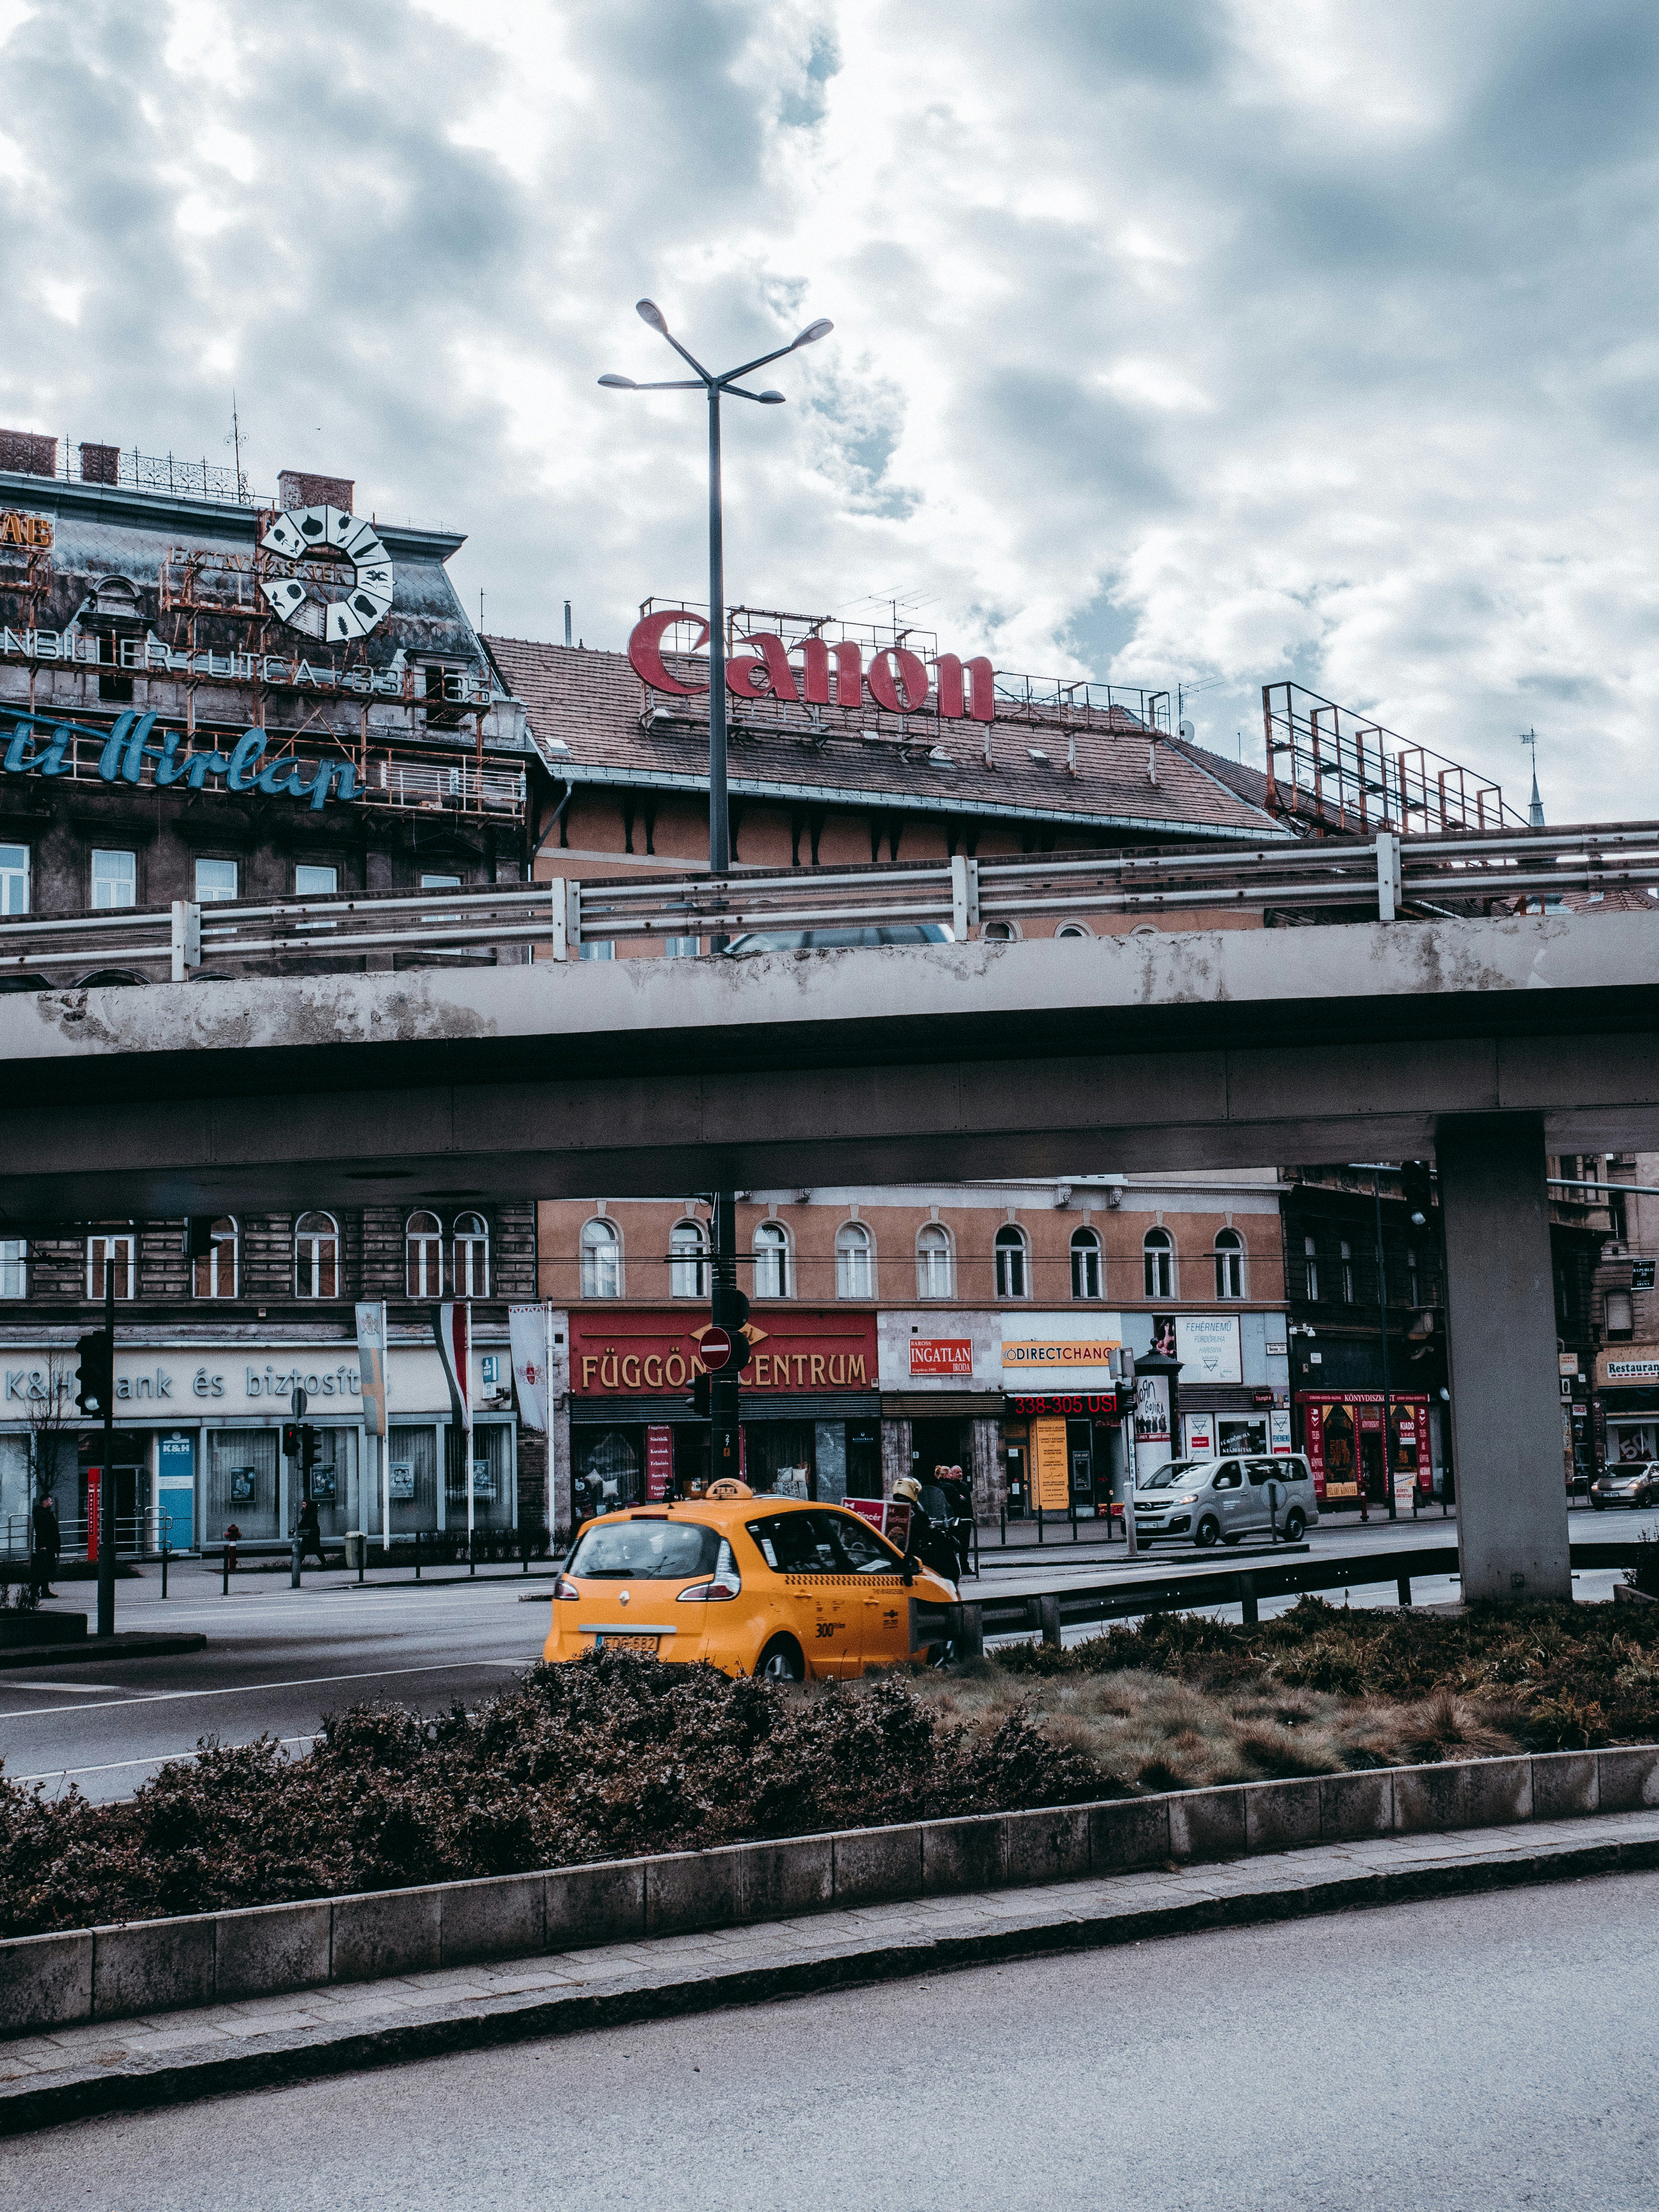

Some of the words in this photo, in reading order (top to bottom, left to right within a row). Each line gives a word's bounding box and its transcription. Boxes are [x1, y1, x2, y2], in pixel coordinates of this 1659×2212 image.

[208, 649, 321, 688] UTCA
[628, 610, 995, 721] Canon
[1186, 1321, 1231, 1331] FEHÉRNEMŰ
[911, 1348, 971, 1362] INGATLAN
[1017, 1347, 1112, 1360] DIRECTCHANG
[582, 1347, 707, 1388] FÜGGÖN
[953, 1363, 971, 1372] IRODA
[6, 1369, 74, 1400] K&H
[117, 1368, 172, 1398] ank
[194, 1368, 225, 1396] és
[1015, 1396, 1083, 1413] 338-305
[1089, 1395, 1117, 1412] US
[1400, 1420, 1415, 1430] KIADÓ
[815, 1623, 834, 1638] 300
